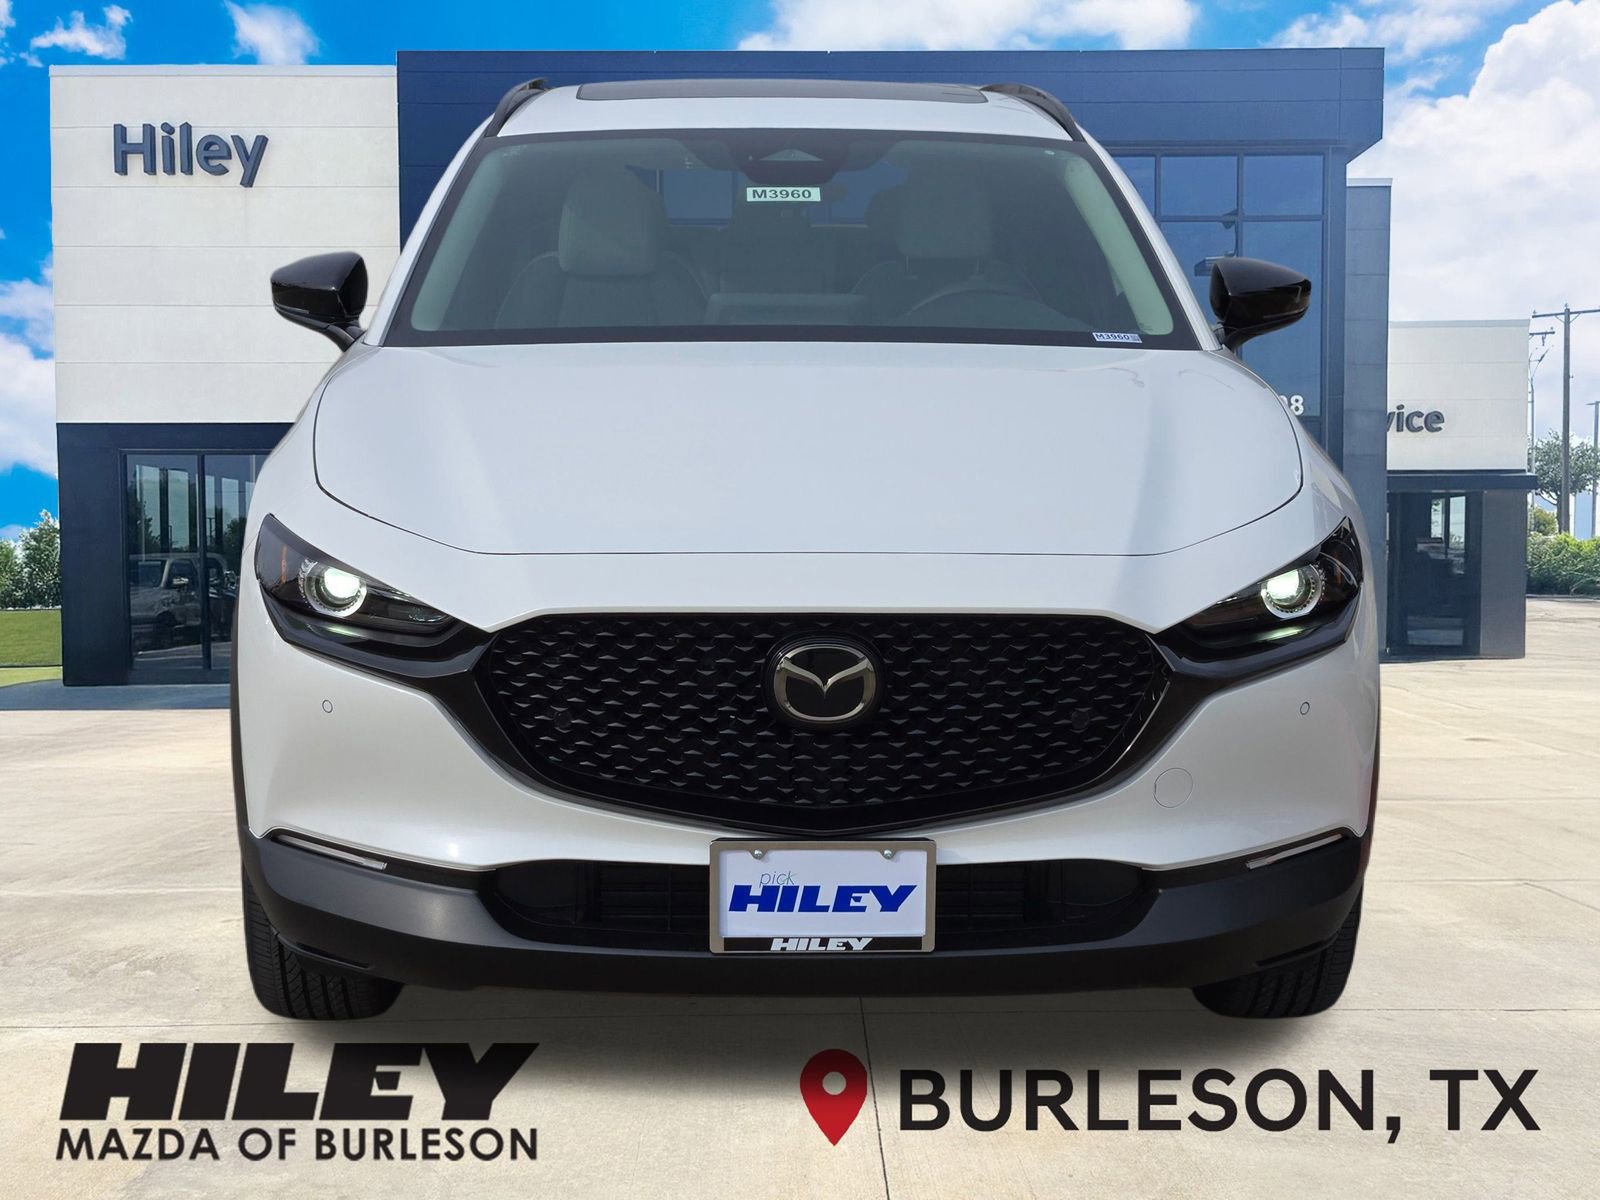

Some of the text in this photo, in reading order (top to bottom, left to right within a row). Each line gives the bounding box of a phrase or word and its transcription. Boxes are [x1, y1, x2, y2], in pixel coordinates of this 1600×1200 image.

[113, 121, 269, 188] Hiley
[752, 189, 812, 199] M3960
[1095, 333, 1130, 341] M3960
[759, 871, 795, 887] pick
[728, 884, 917, 913] HILEY
[770, 937, 873, 951] HILEY
